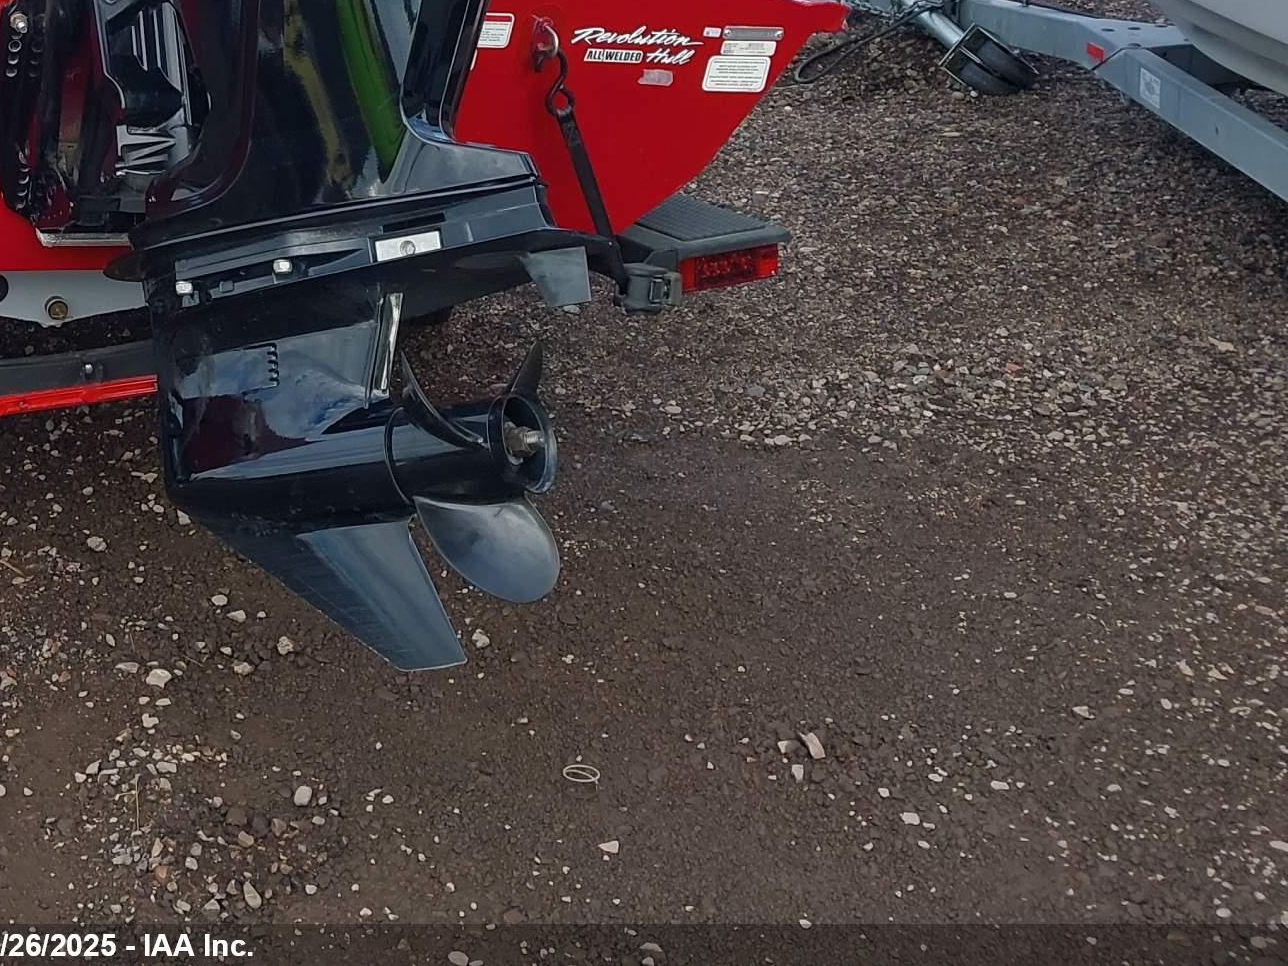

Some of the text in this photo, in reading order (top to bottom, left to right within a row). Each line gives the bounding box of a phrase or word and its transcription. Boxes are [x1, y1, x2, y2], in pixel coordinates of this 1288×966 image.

[571, 25, 705, 47] Revolution
[586, 48, 696, 65] ALL WELDED Hull
